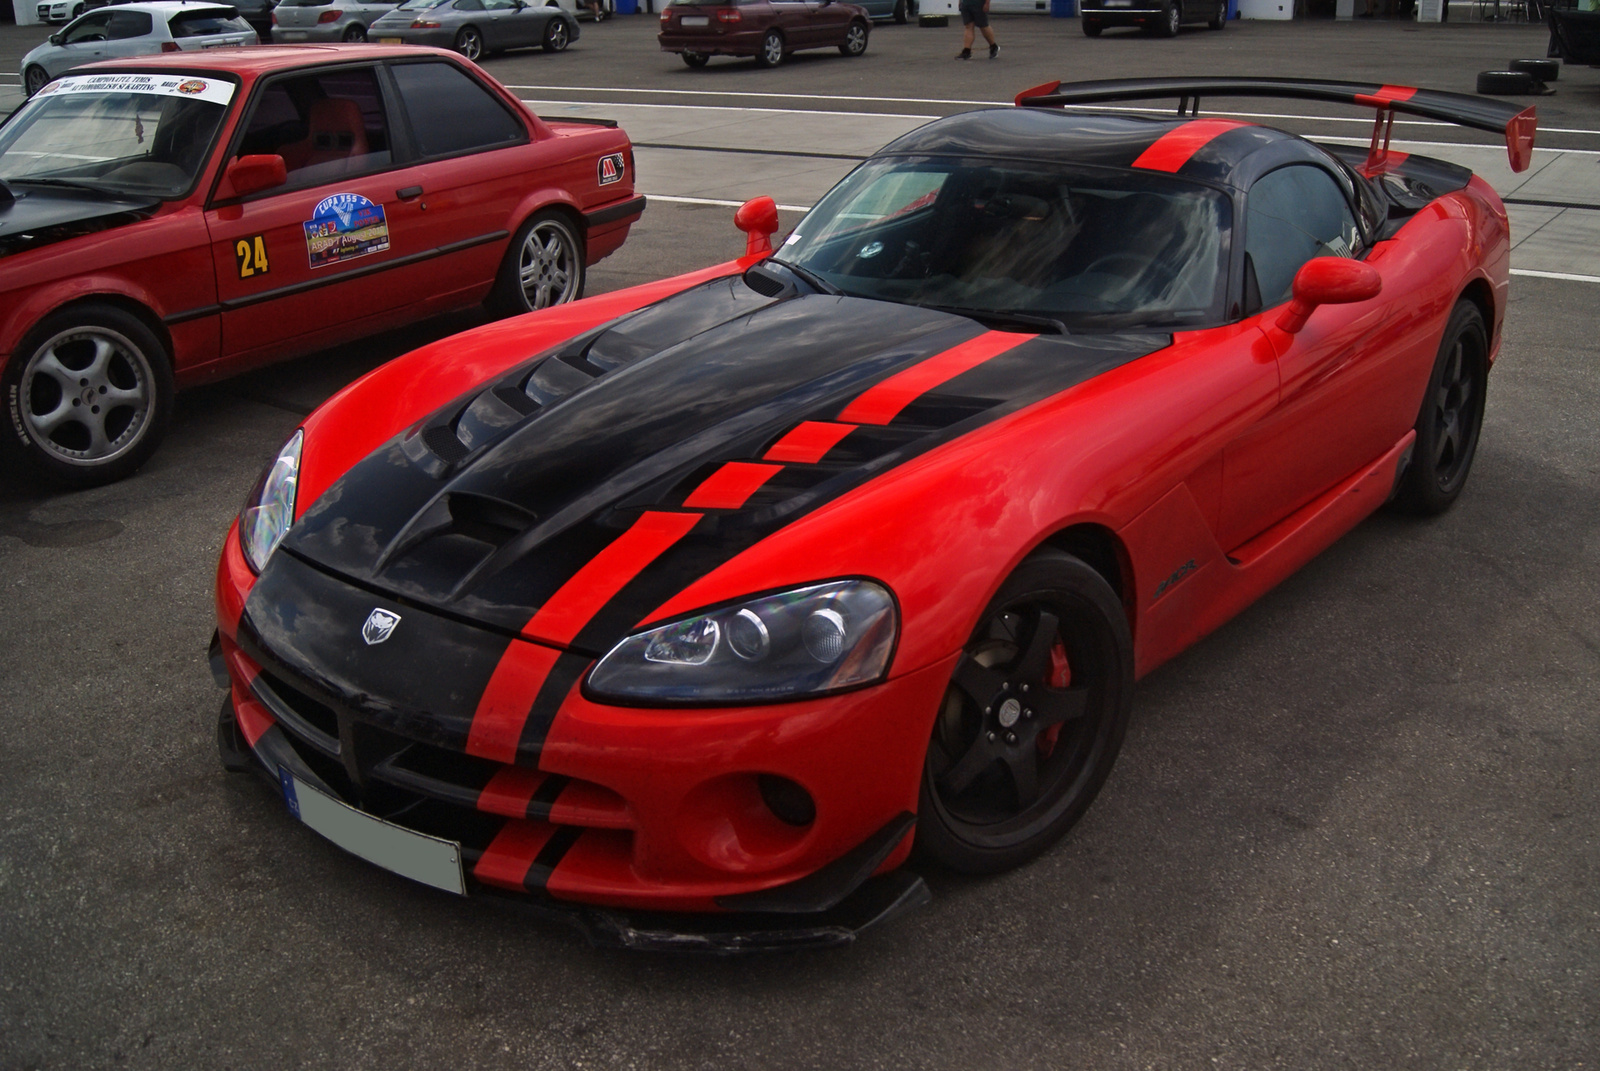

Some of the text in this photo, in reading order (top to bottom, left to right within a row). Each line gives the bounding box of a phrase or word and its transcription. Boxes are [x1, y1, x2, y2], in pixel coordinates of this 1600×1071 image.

[125, 83, 156, 91] KARTING
[318, 194, 368, 215] CUPA VSS 3
[311, 238, 334, 251] ARAD
[341, 231, 367, 247] August
[236, 236, 269, 277] 24
[288, 797, 299, 813] CZ
